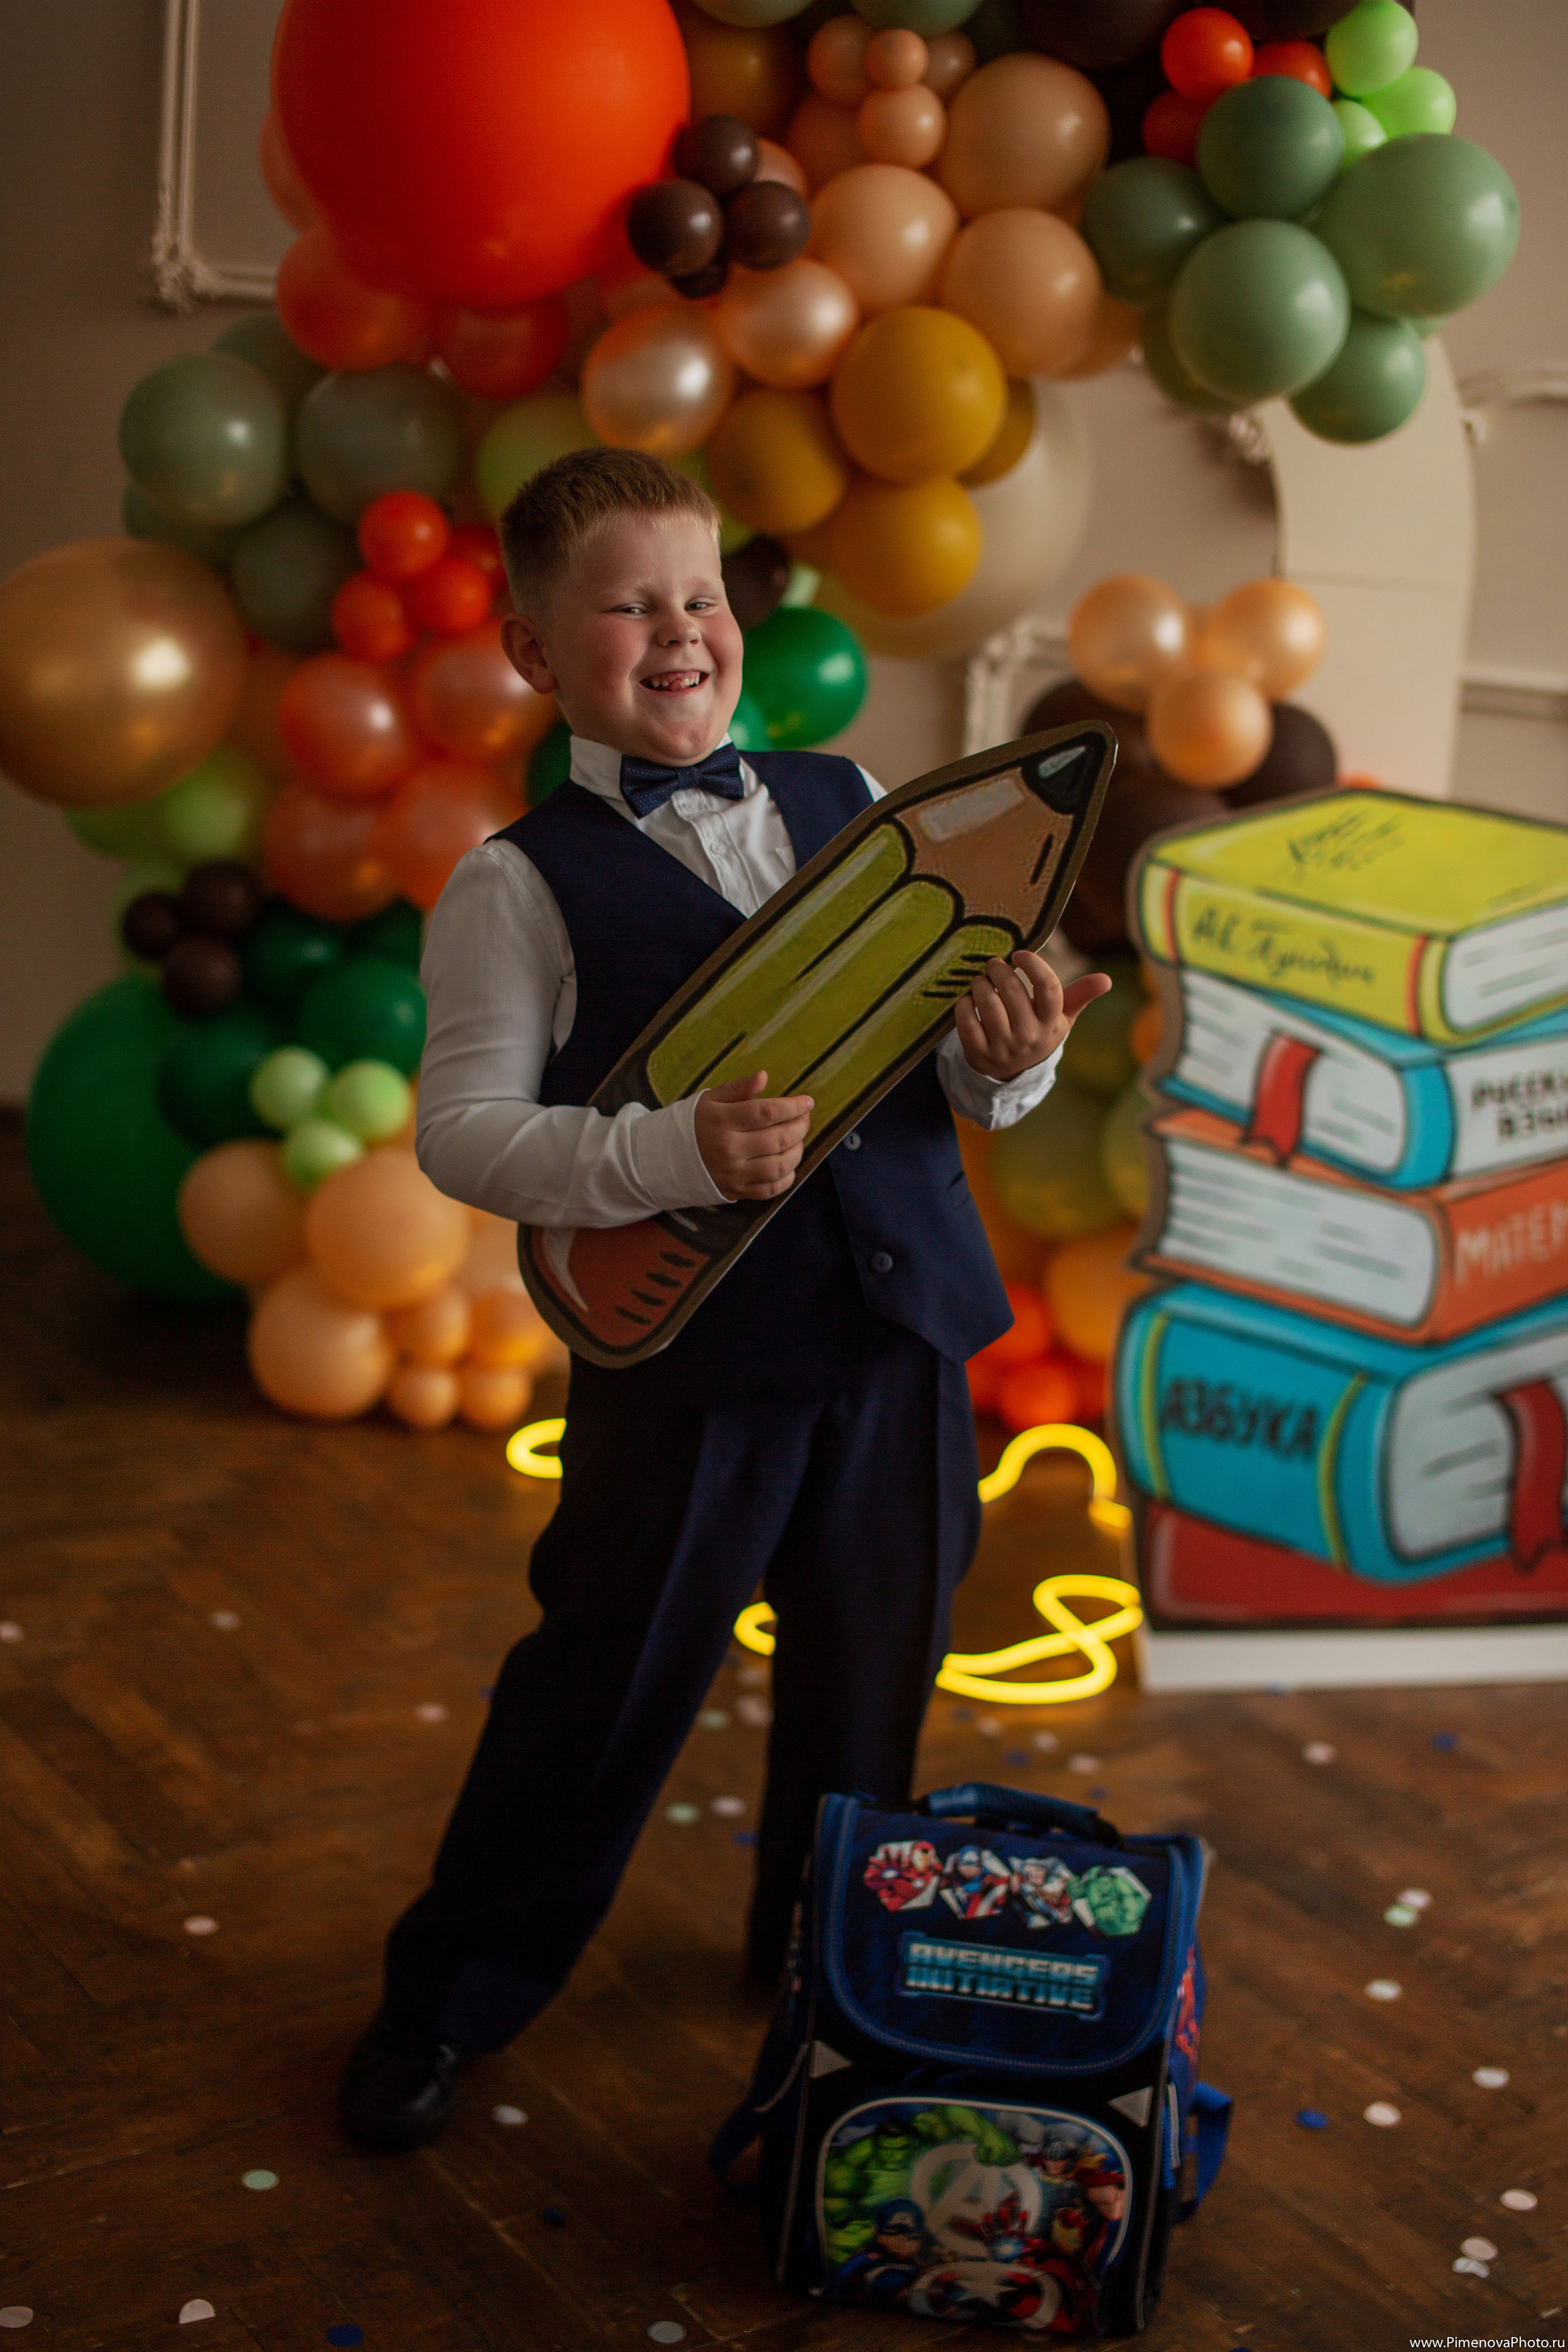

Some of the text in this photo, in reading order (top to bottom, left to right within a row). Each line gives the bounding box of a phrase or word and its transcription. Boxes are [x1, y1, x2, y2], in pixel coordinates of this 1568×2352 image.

[1159, 1376, 1318, 1460] АЗБУКА
[909, 1942, 1099, 1985] AVENGERS
[905, 1965, 1095, 2010] INITIATIVE
